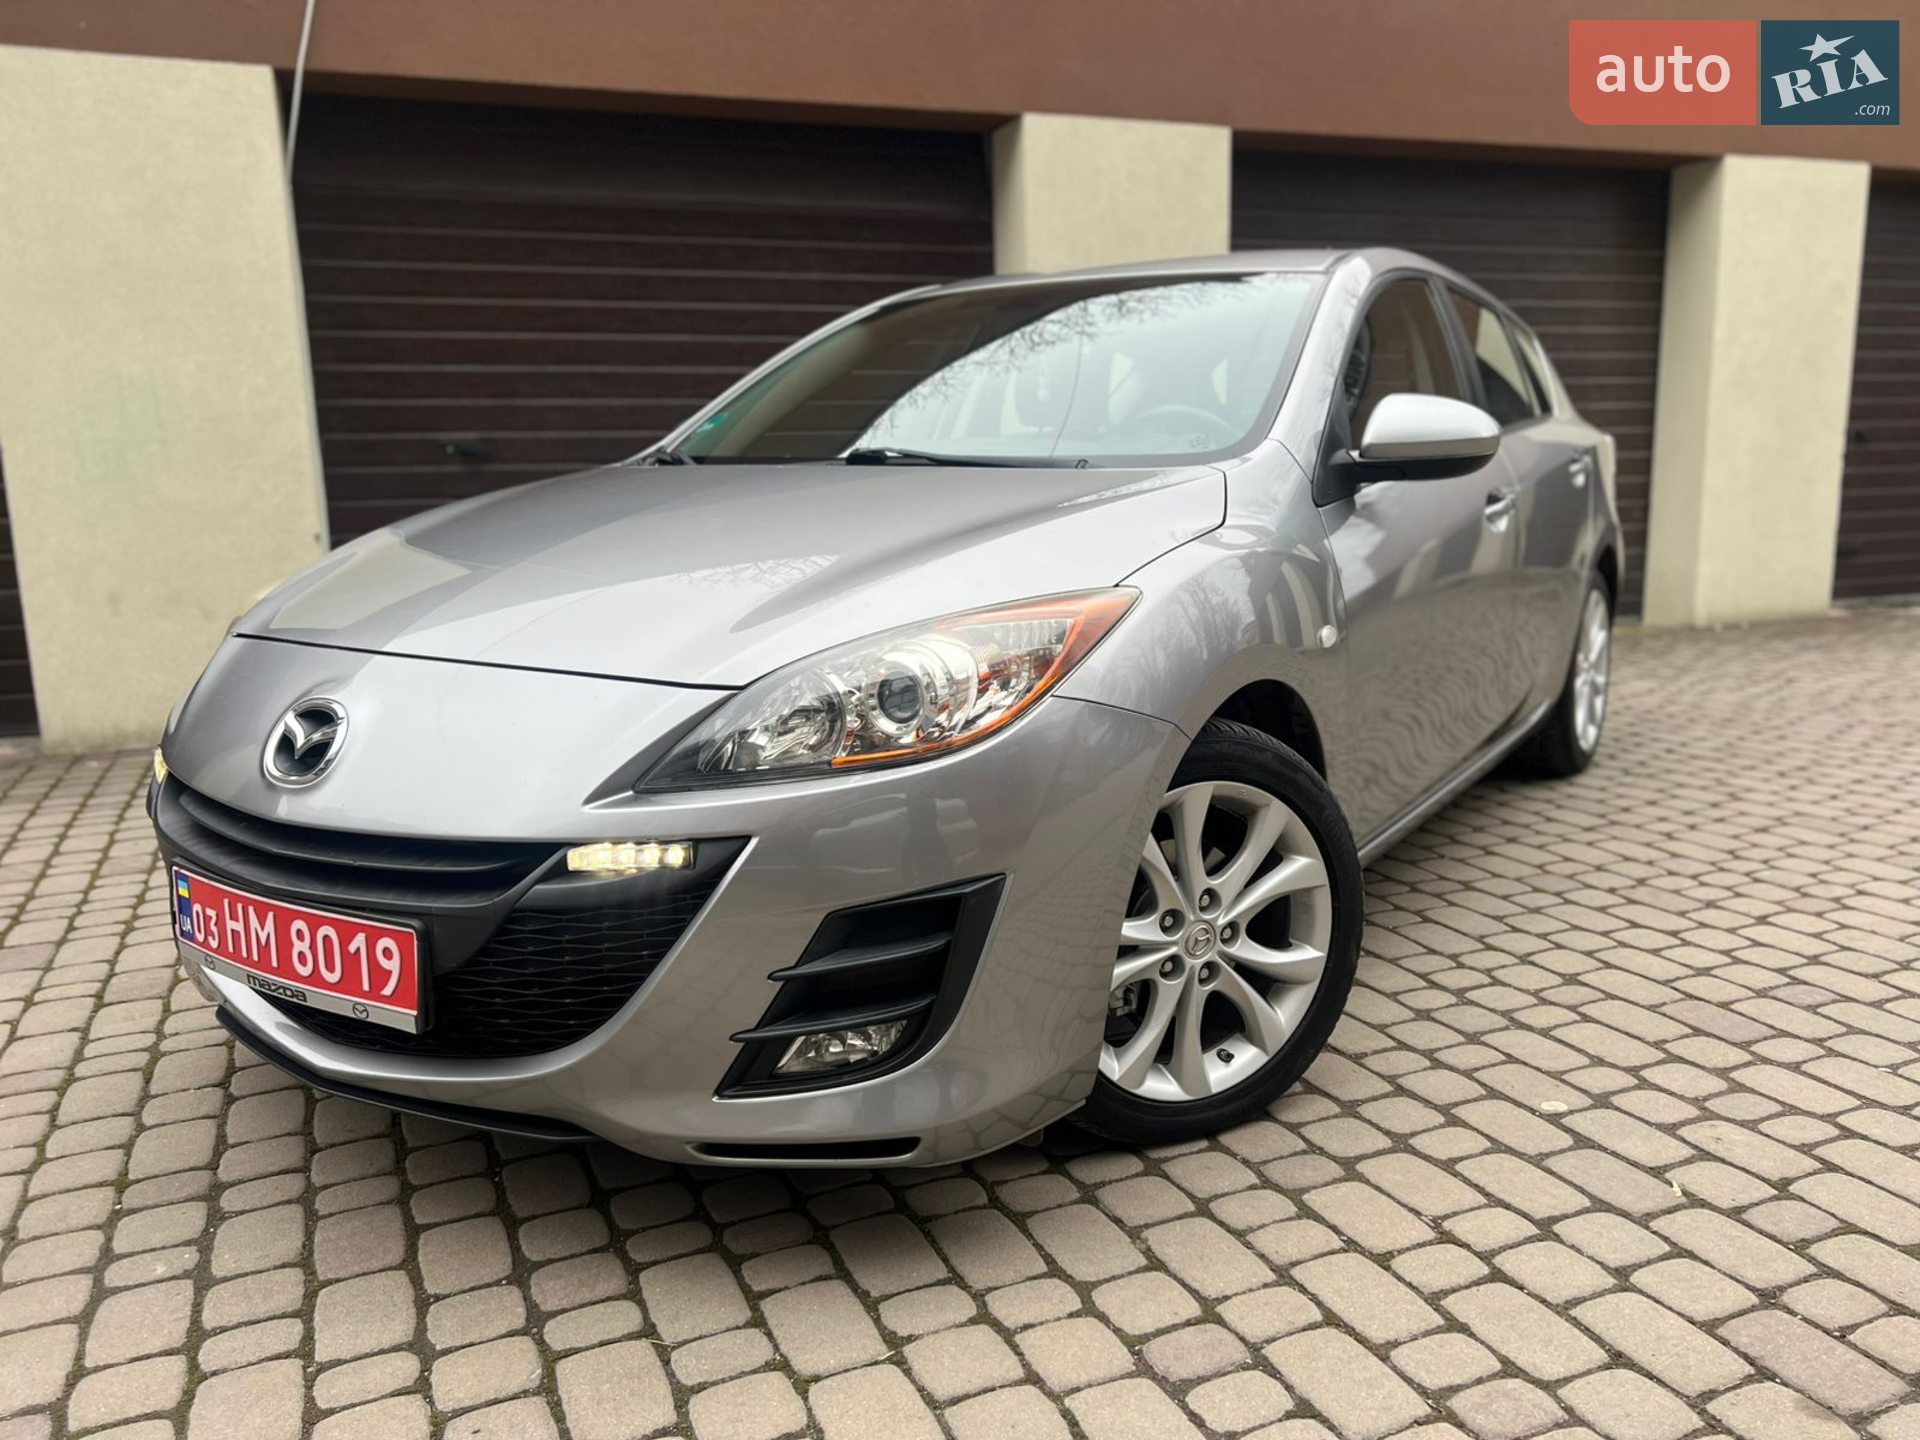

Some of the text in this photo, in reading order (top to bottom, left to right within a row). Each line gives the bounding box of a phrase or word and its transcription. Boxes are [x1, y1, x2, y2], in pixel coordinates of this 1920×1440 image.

[180, 914, 193, 934] UA
[193, 898, 401, 997] 03 HM 8019
